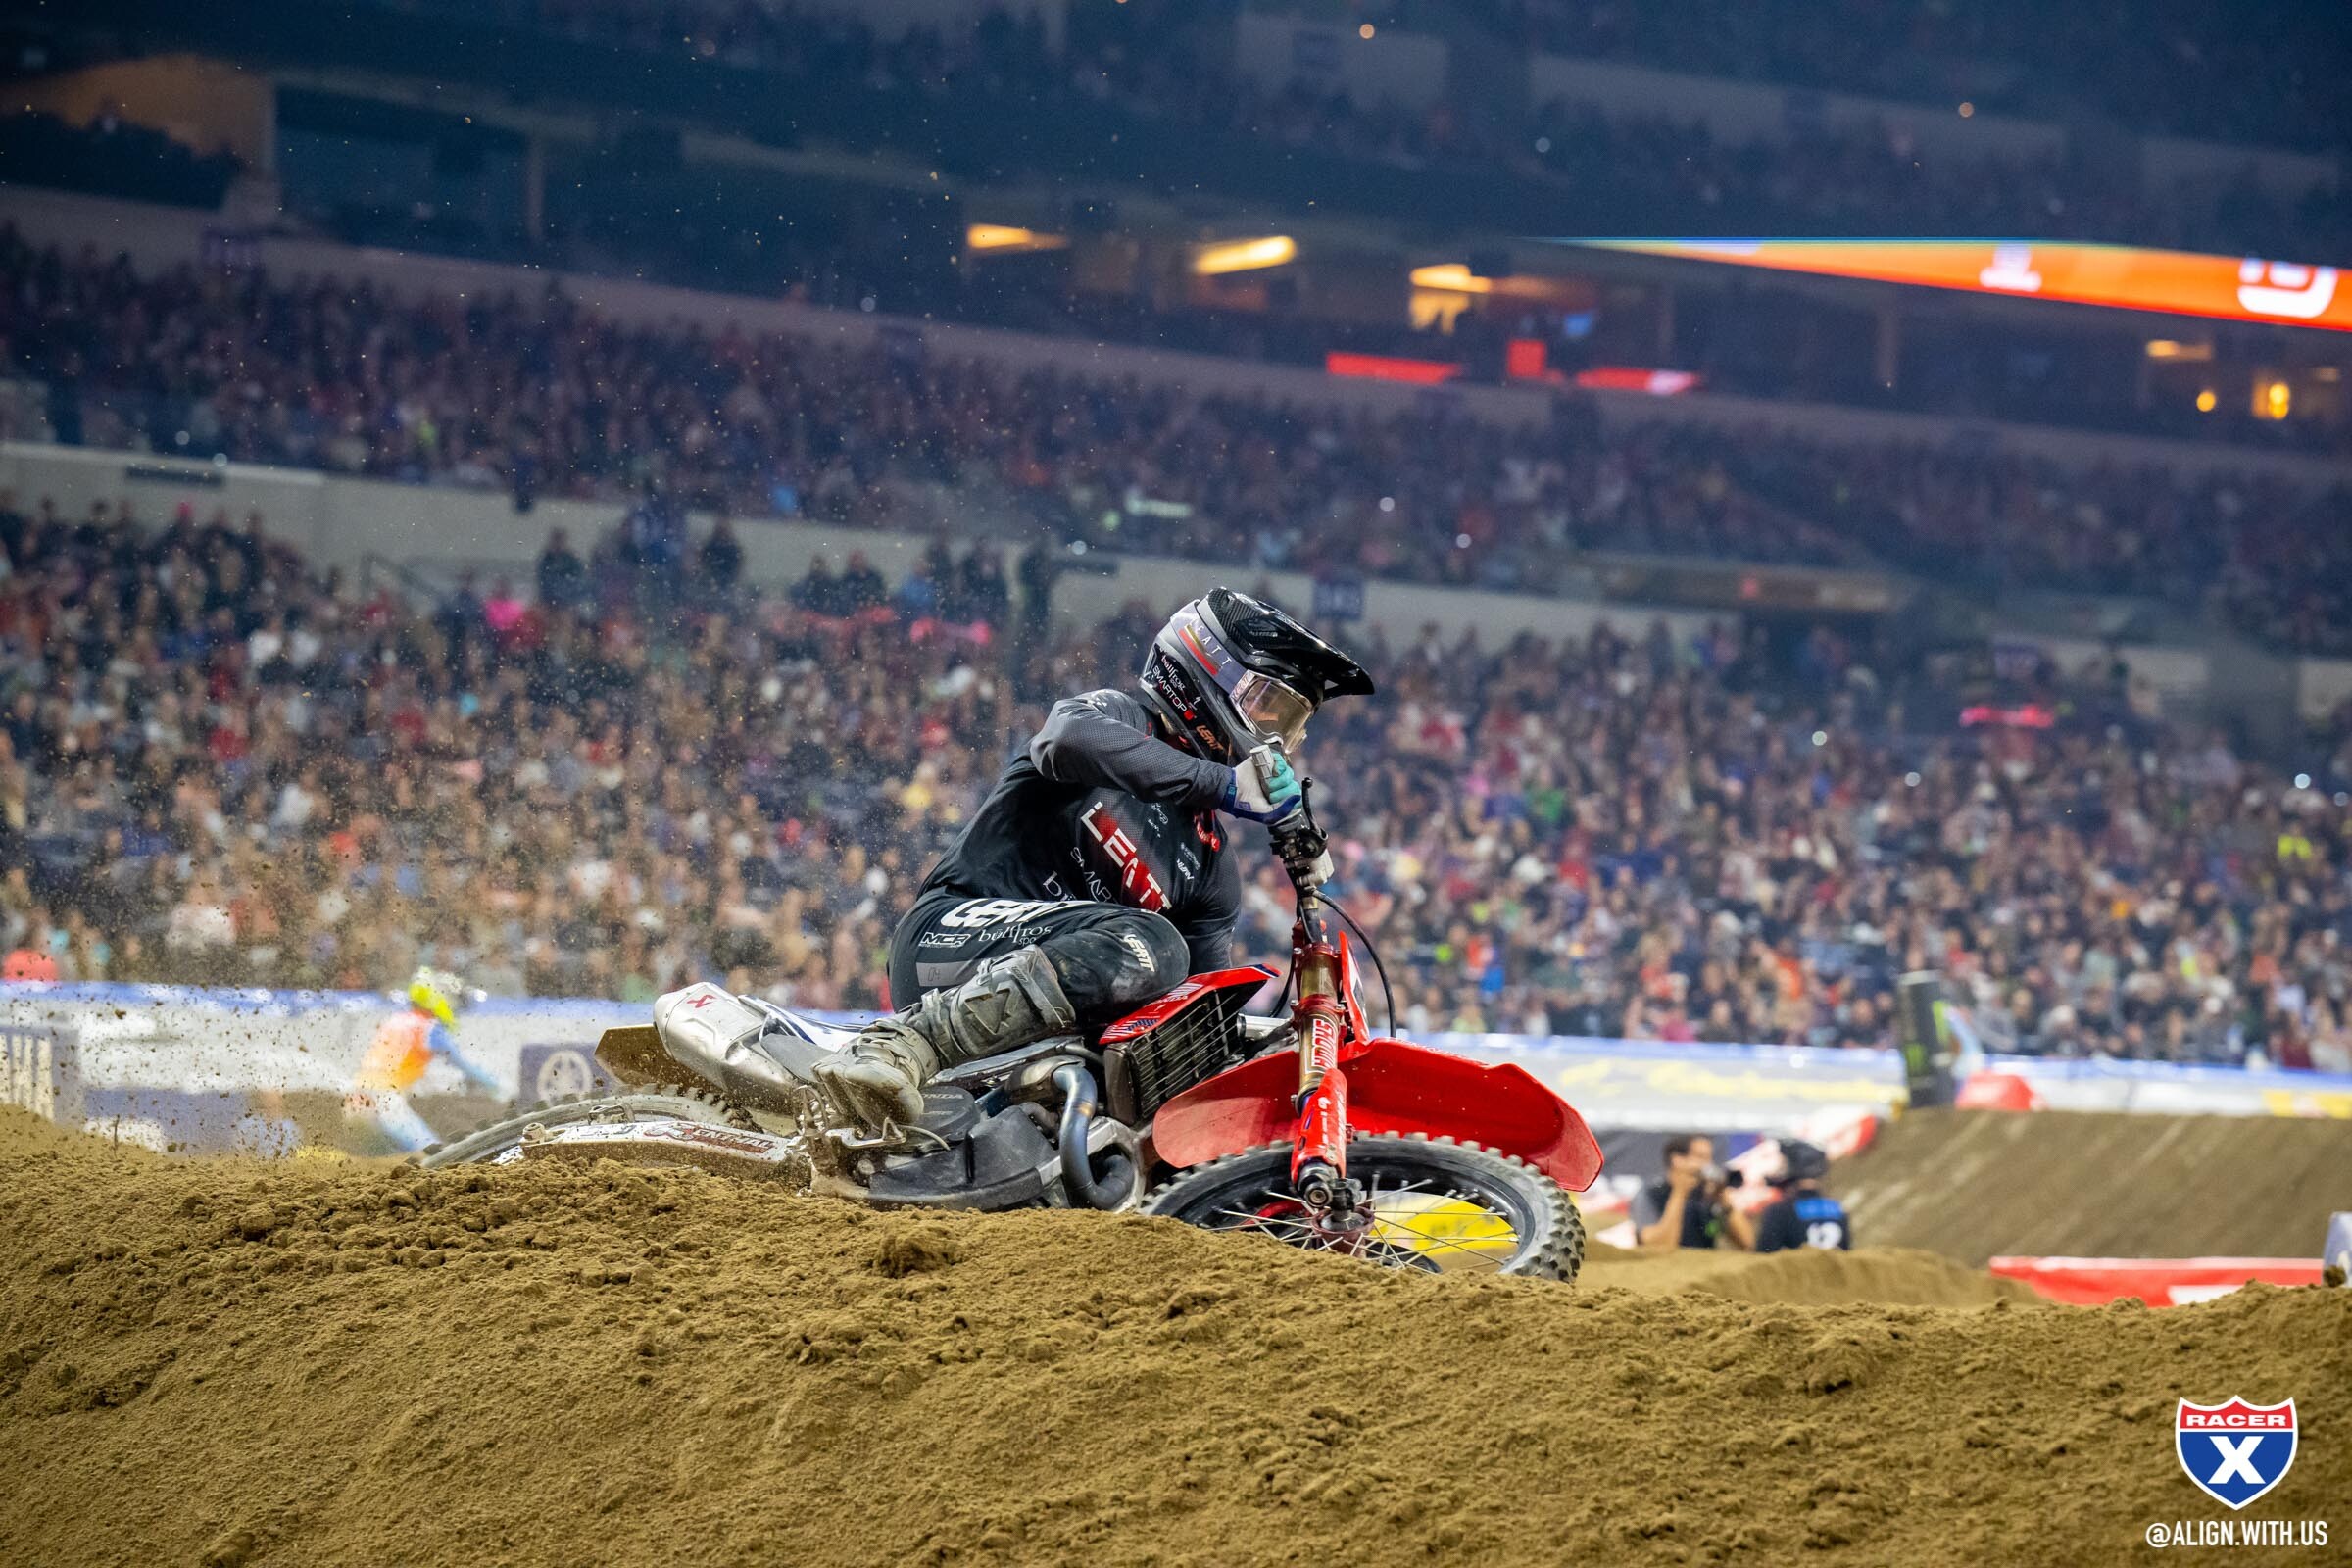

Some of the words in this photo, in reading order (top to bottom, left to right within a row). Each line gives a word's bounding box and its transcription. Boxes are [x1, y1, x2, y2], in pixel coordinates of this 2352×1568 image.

[1152, 664, 1188, 714] SMARTOP
[1195, 724, 1225, 752] LEATT
[1081, 801, 1172, 913] LEATT
[1124, 933, 1155, 973] LEATT
